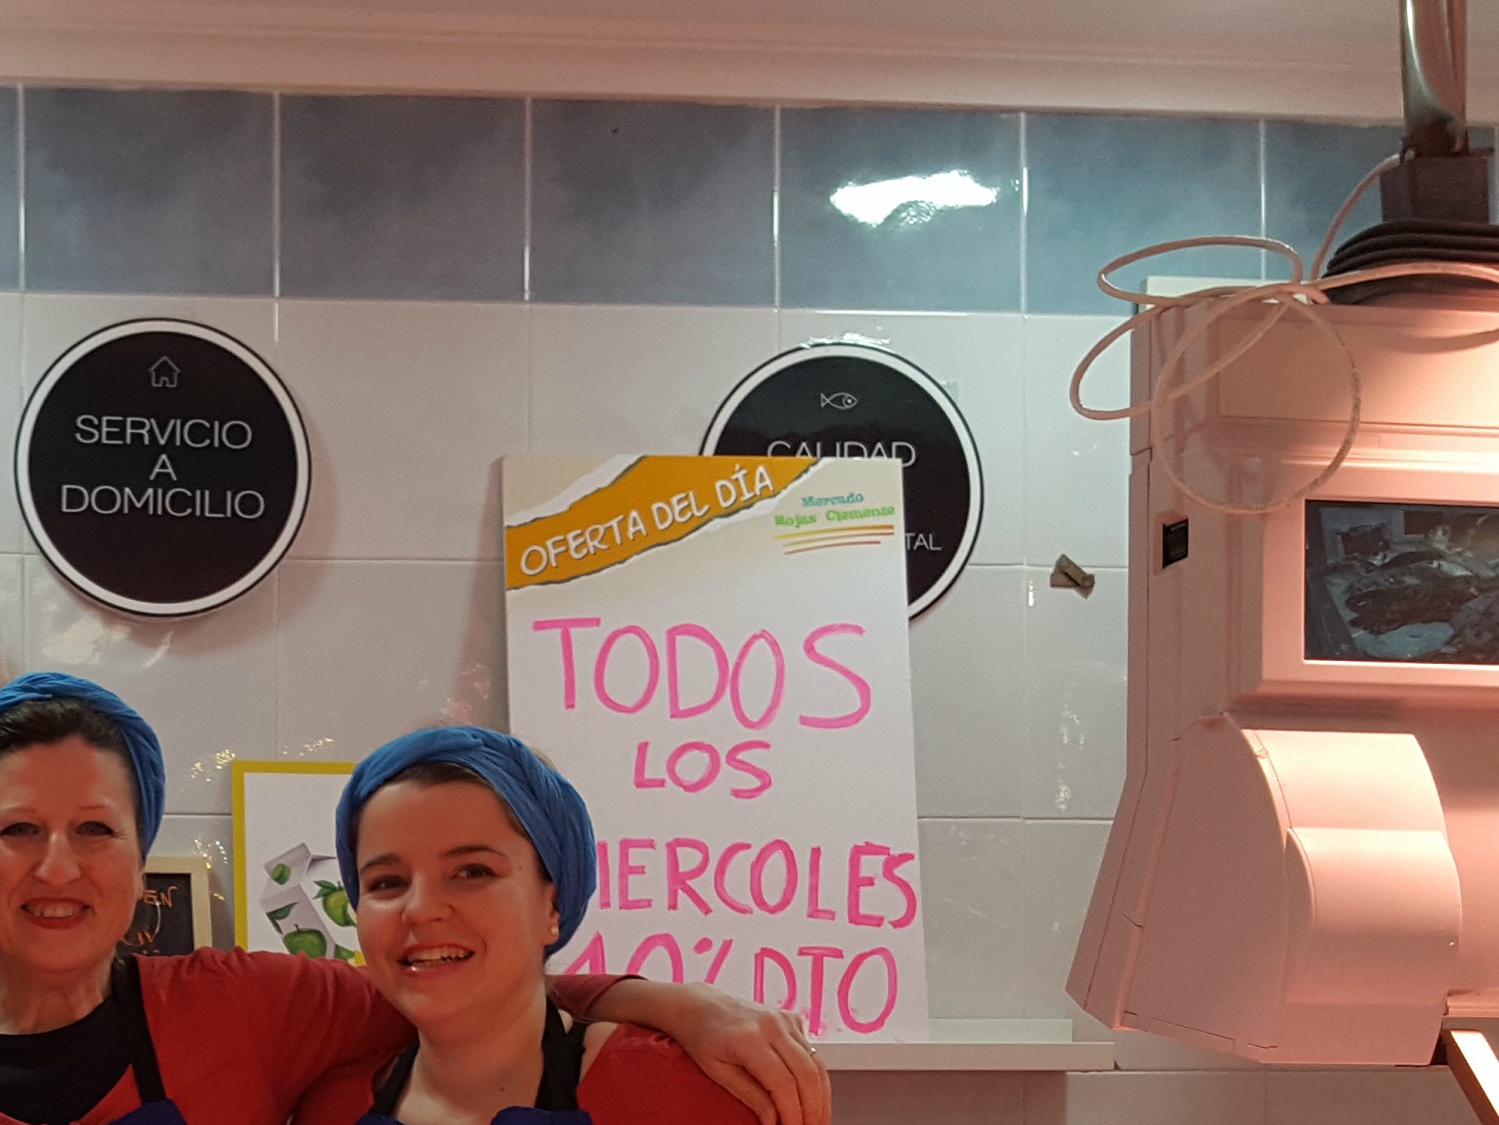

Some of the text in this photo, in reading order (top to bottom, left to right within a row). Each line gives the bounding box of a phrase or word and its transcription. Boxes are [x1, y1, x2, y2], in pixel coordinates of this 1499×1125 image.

[74, 414, 252, 449] SERVICIO
[149, 454, 178, 481] A
[60, 484, 265, 519] DOMICILIO
[520, 464, 775, 576] OFERTA DEL DÍA
[774, 506, 894, 528] Rojas Clemente
[802, 492, 863, 506] Mercado
[532, 616, 872, 730] TODOS
[633, 740, 773, 799] LOS
[596, 837, 917, 929] IERCOLES
[754, 946, 898, 1037] DTO
